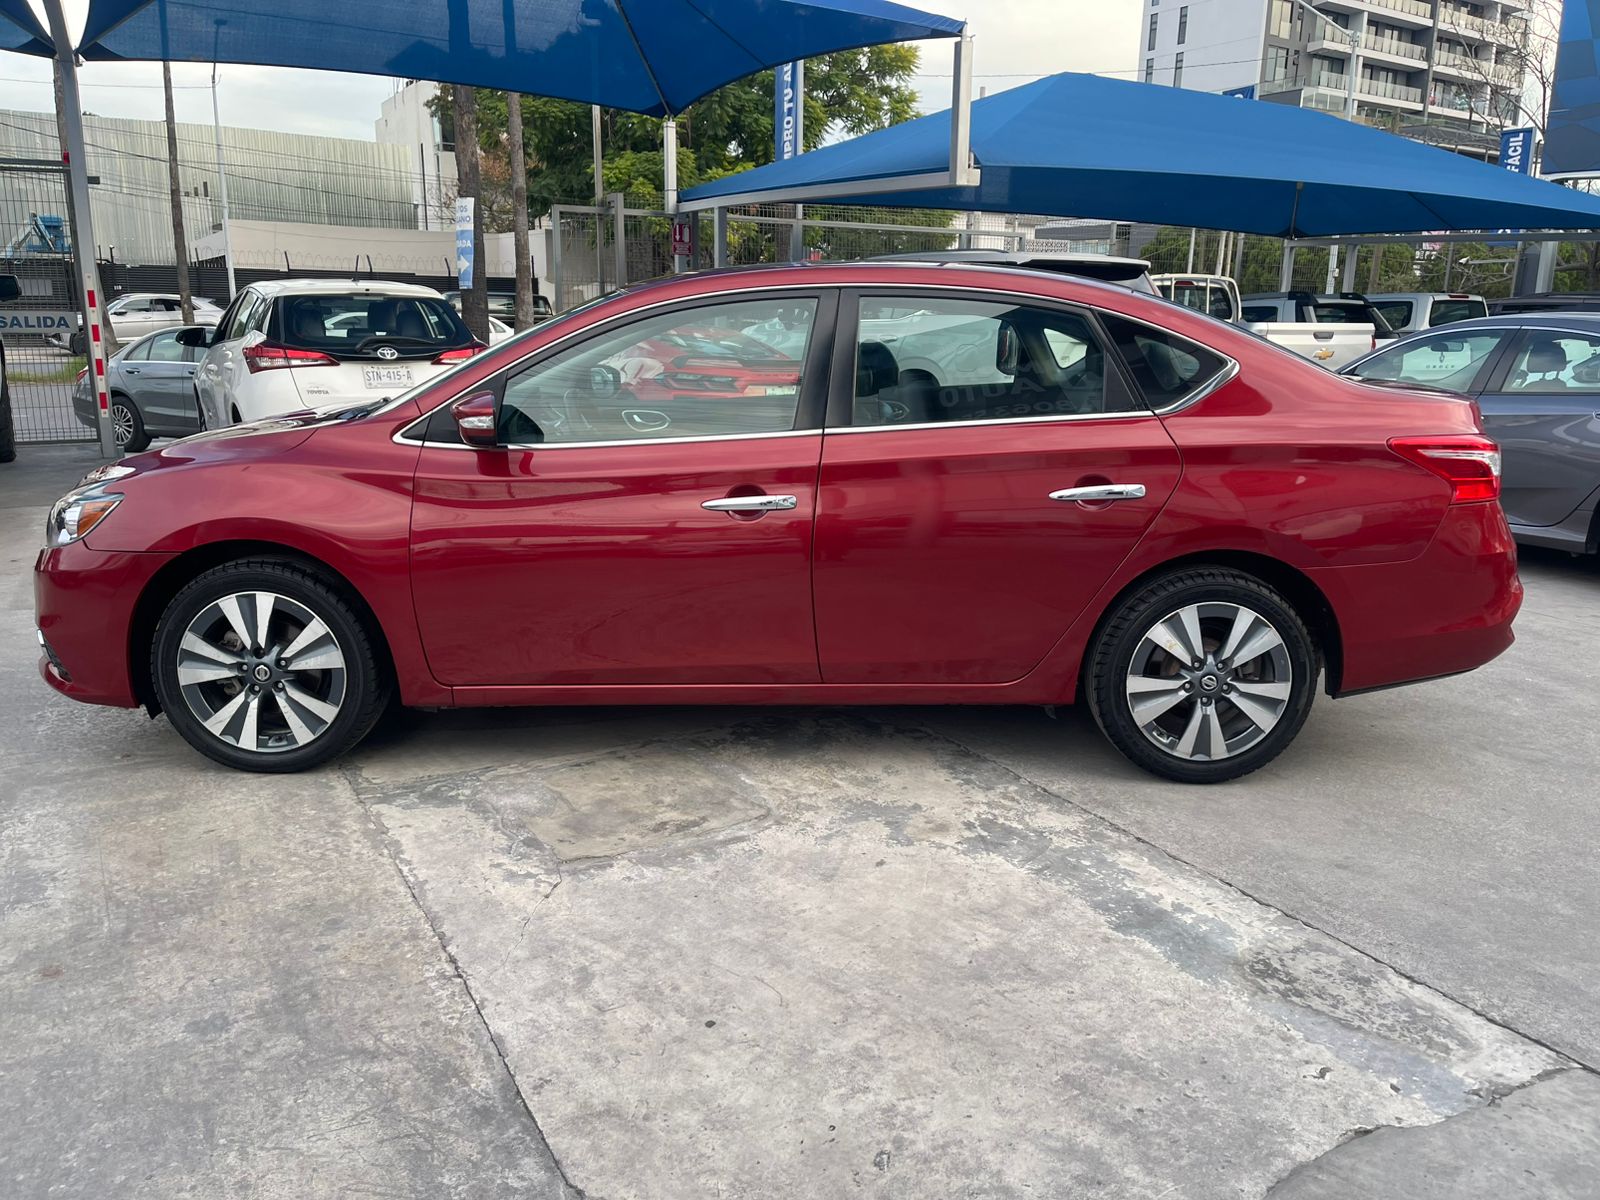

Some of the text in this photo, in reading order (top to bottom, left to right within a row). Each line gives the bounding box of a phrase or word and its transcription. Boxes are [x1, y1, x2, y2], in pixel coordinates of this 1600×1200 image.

[783, 87, 793, 112] TU
[1504, 132, 1524, 173] FÁCIL
[0, 316, 71, 329] SALIDA
[365, 370, 412, 382] STN-415-A
